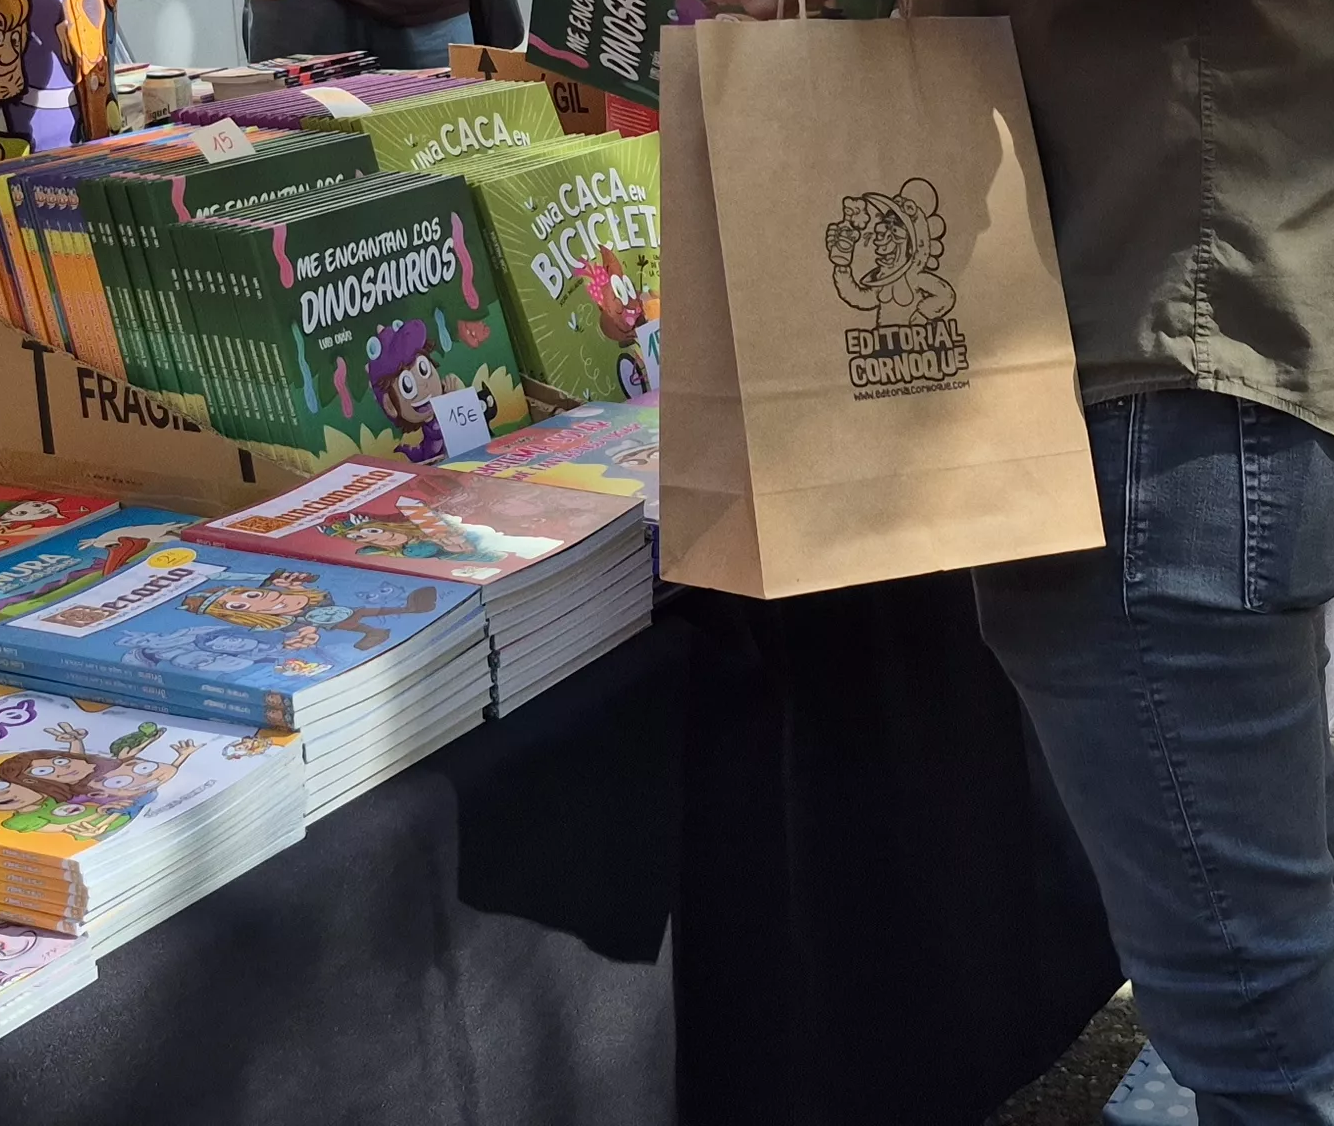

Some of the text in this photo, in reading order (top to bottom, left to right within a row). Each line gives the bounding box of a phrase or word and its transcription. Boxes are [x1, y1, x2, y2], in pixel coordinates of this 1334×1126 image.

[566, 26, 591, 56] ME
[553, 81, 589, 114] GIL
[213, 131, 234, 154] 15
[440, 112, 513, 157] CACA
[559, 167, 631, 218] CACA
[297, 217, 442, 281] ME ENCANTAN LOS
[531, 204, 661, 301] BICICLET
[300, 237, 457, 335] DINOSAURIOS
[845, 319, 966, 355] EDITORIAL
[849, 345, 970, 387] CORNOQUE
[76, 366, 202, 433] FRAG
[854, 381, 971, 401] www.editorialcornoque.com
[448, 405, 478, 427] 15€
